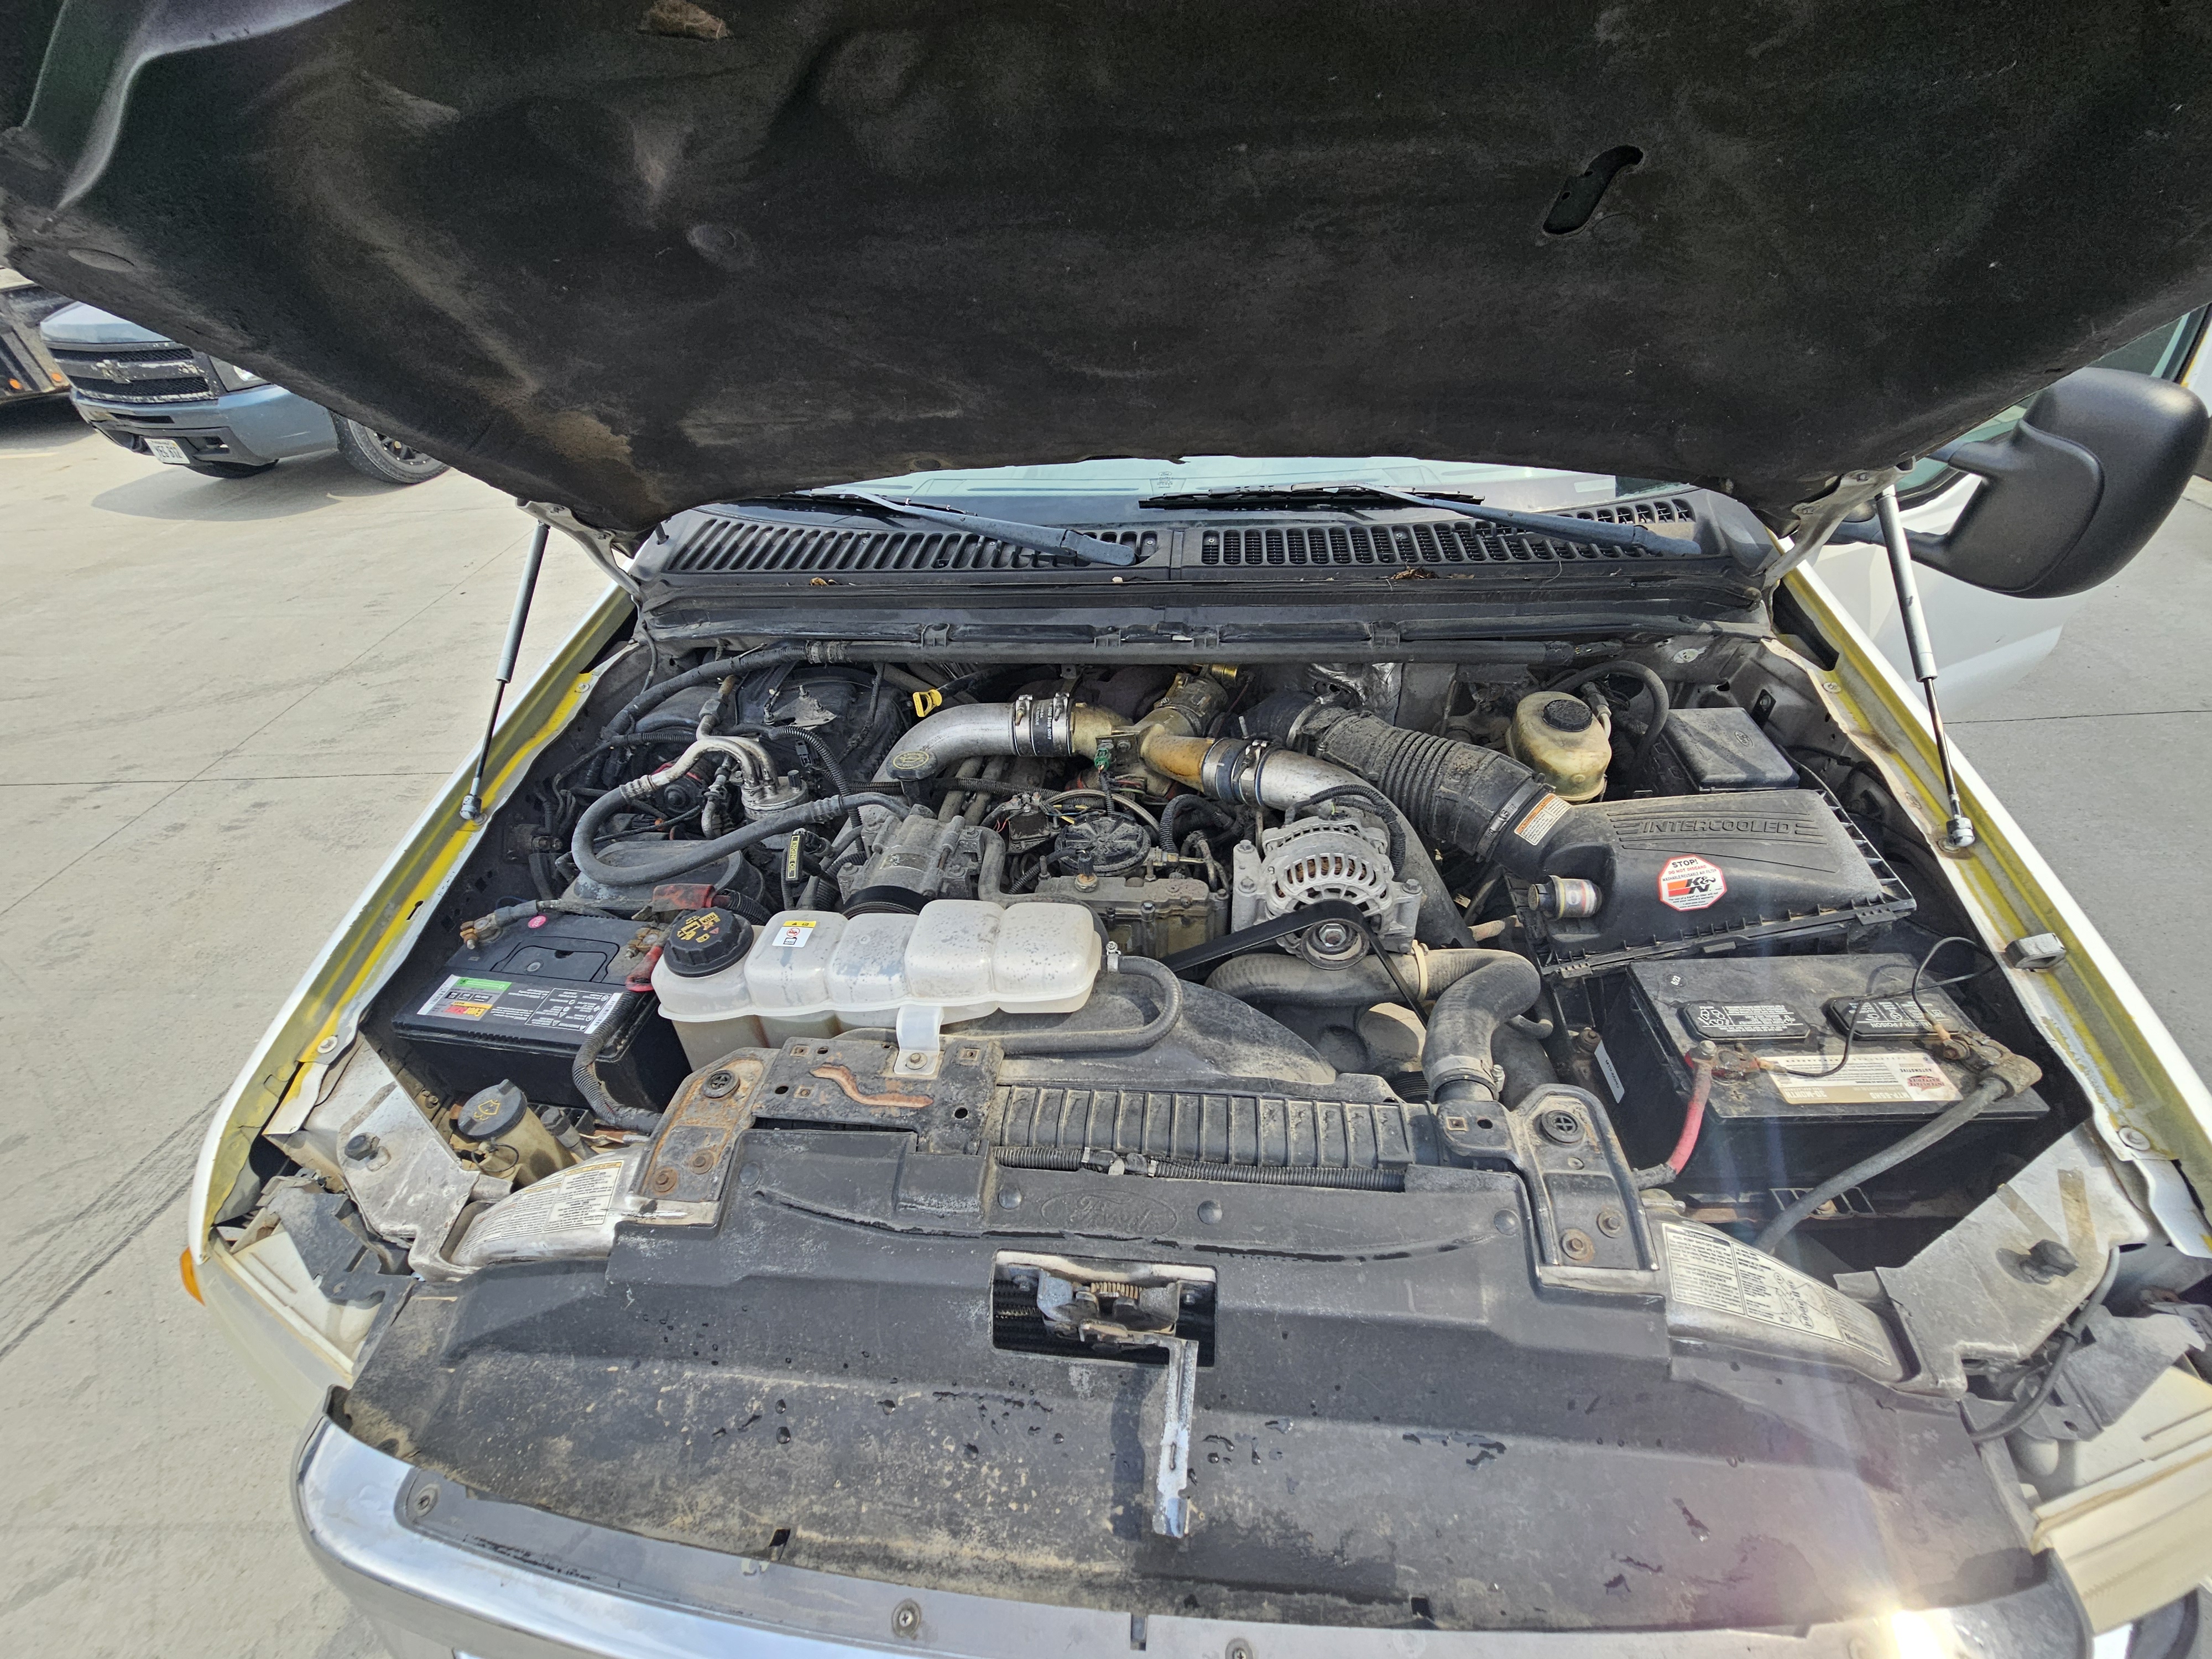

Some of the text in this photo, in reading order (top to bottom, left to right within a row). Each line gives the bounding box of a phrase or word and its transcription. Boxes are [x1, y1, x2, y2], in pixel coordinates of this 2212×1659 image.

[1642, 819, 1790, 834] INTERCOOLED
[1672, 859, 1698, 868] STOP!
[442, 1005, 485, 1018] EverStart
[1784, 1090, 1827, 1098] 30-MONTH
